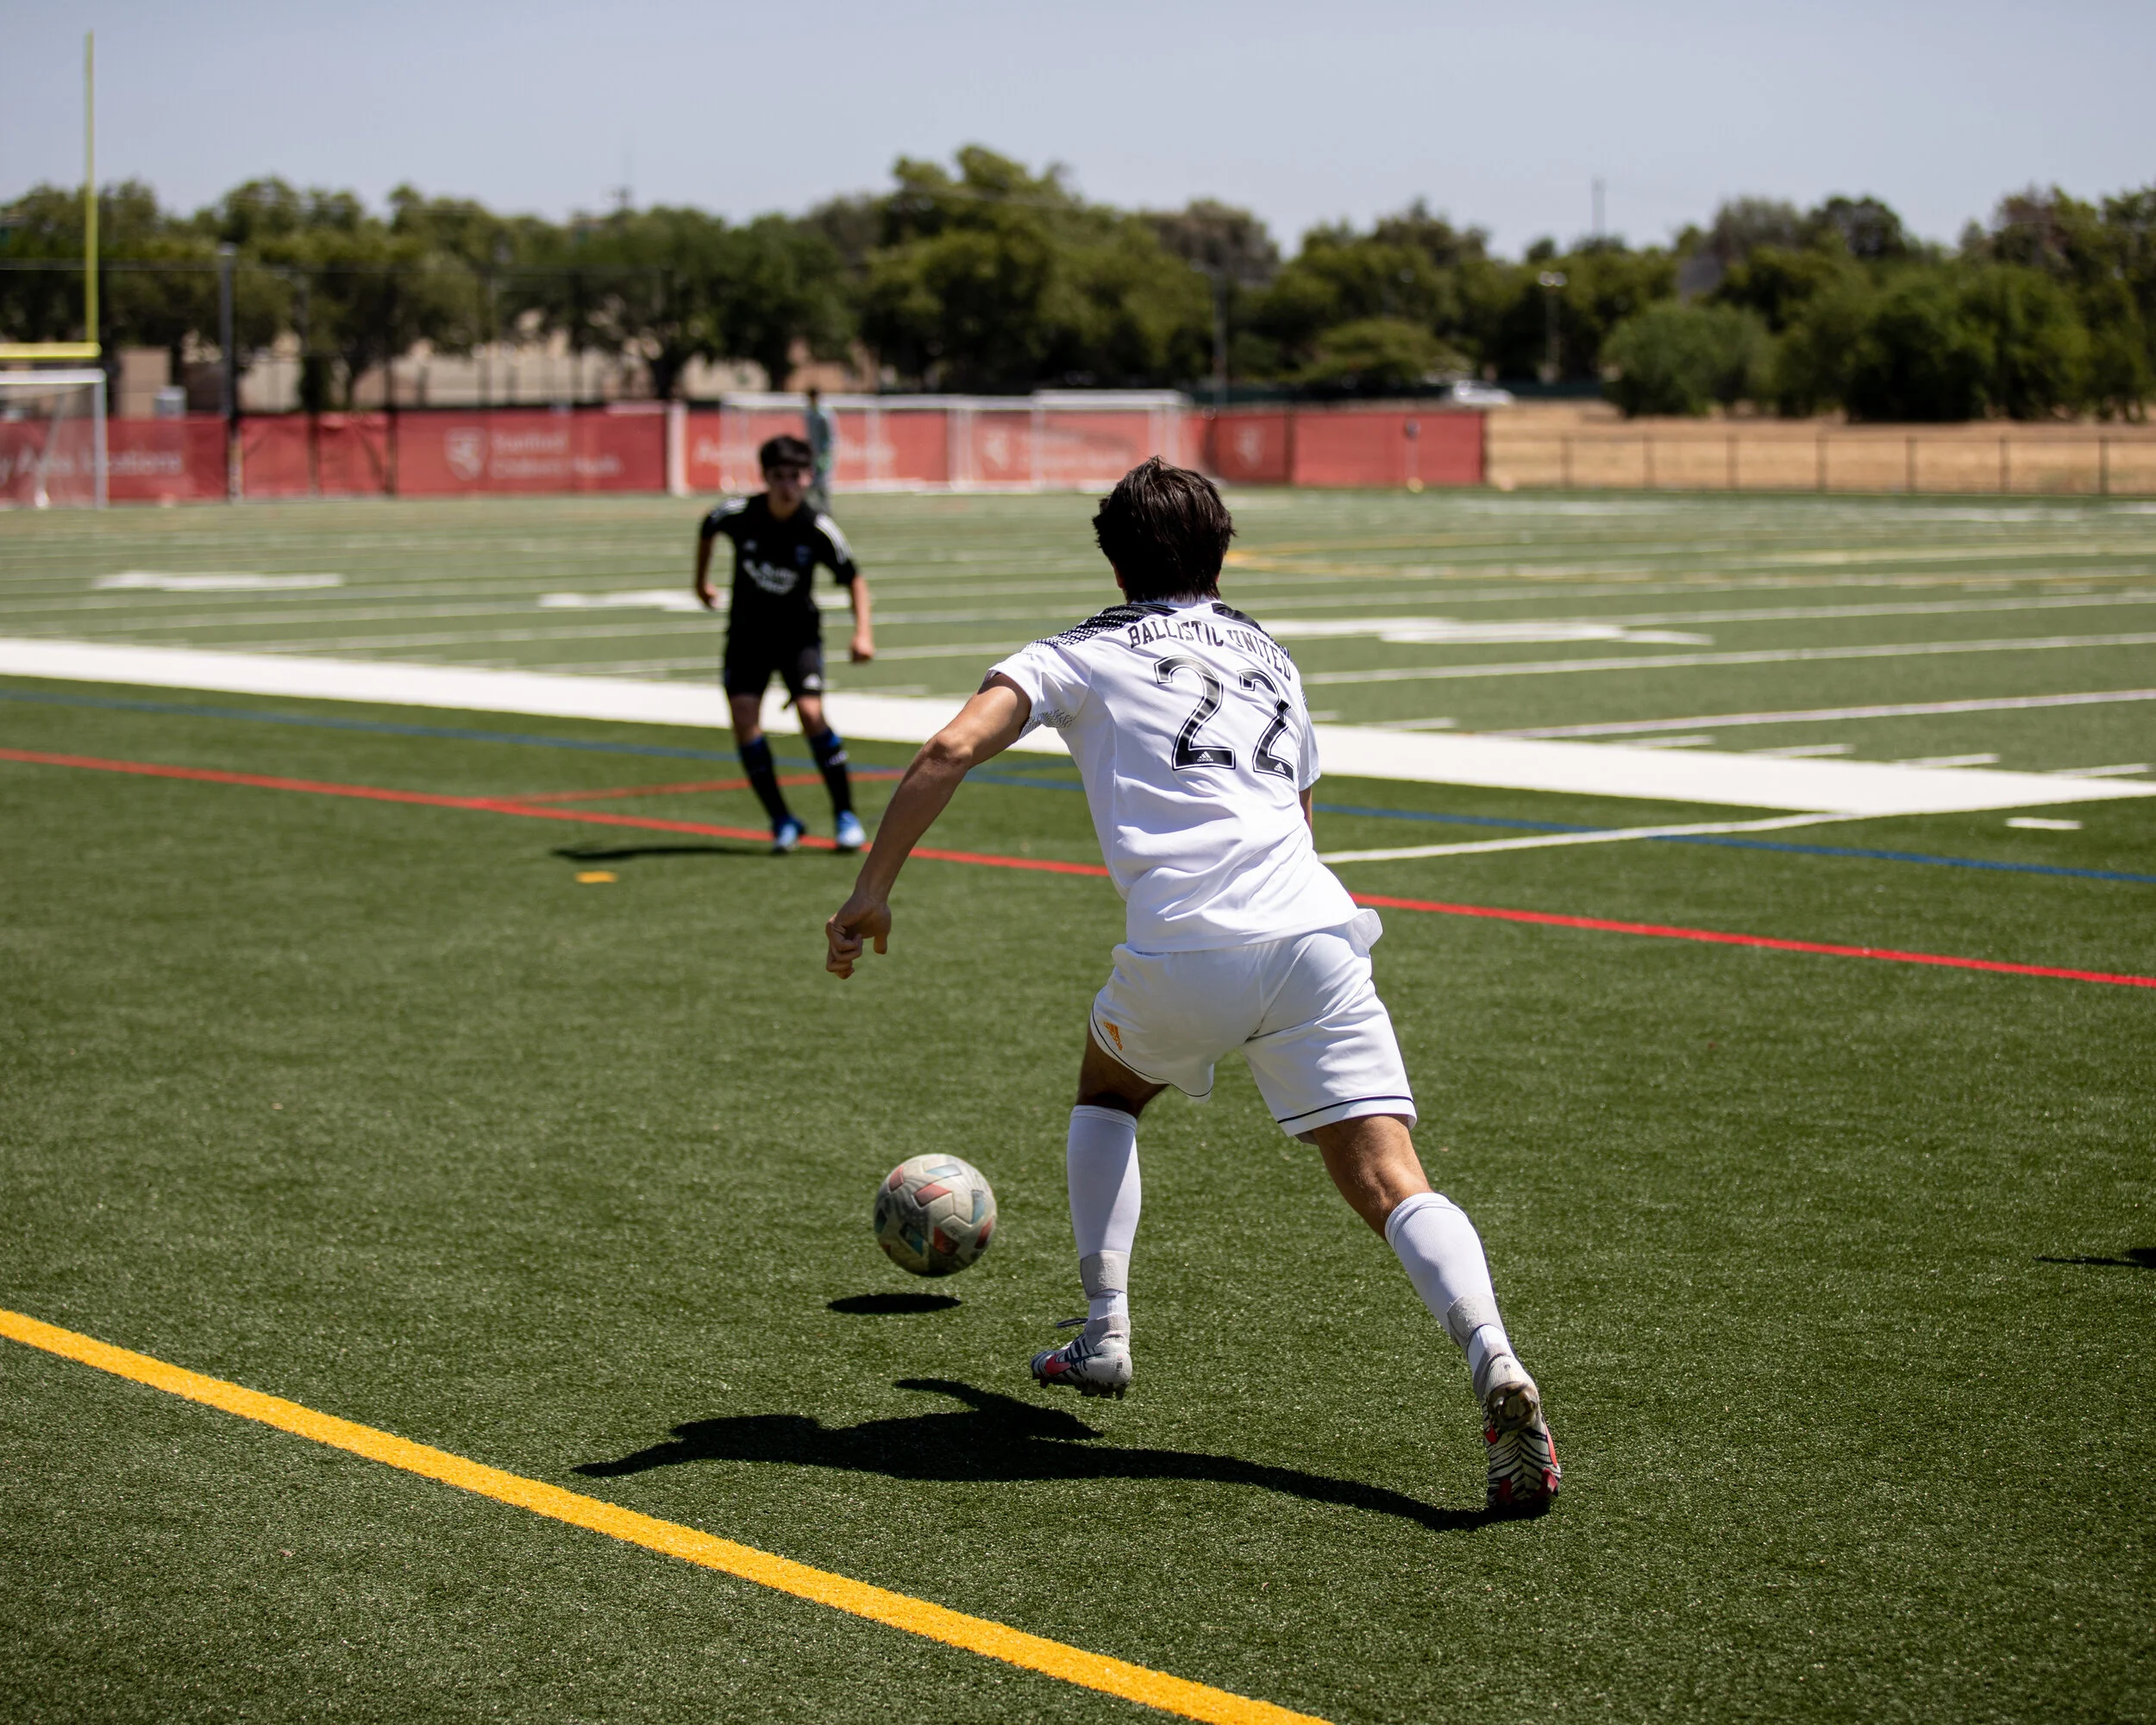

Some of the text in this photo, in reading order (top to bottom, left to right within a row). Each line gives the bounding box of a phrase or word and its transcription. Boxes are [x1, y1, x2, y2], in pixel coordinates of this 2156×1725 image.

[1127, 618, 1291, 681] BALLISTIC UNITED
[1154, 655, 1294, 783] 22
